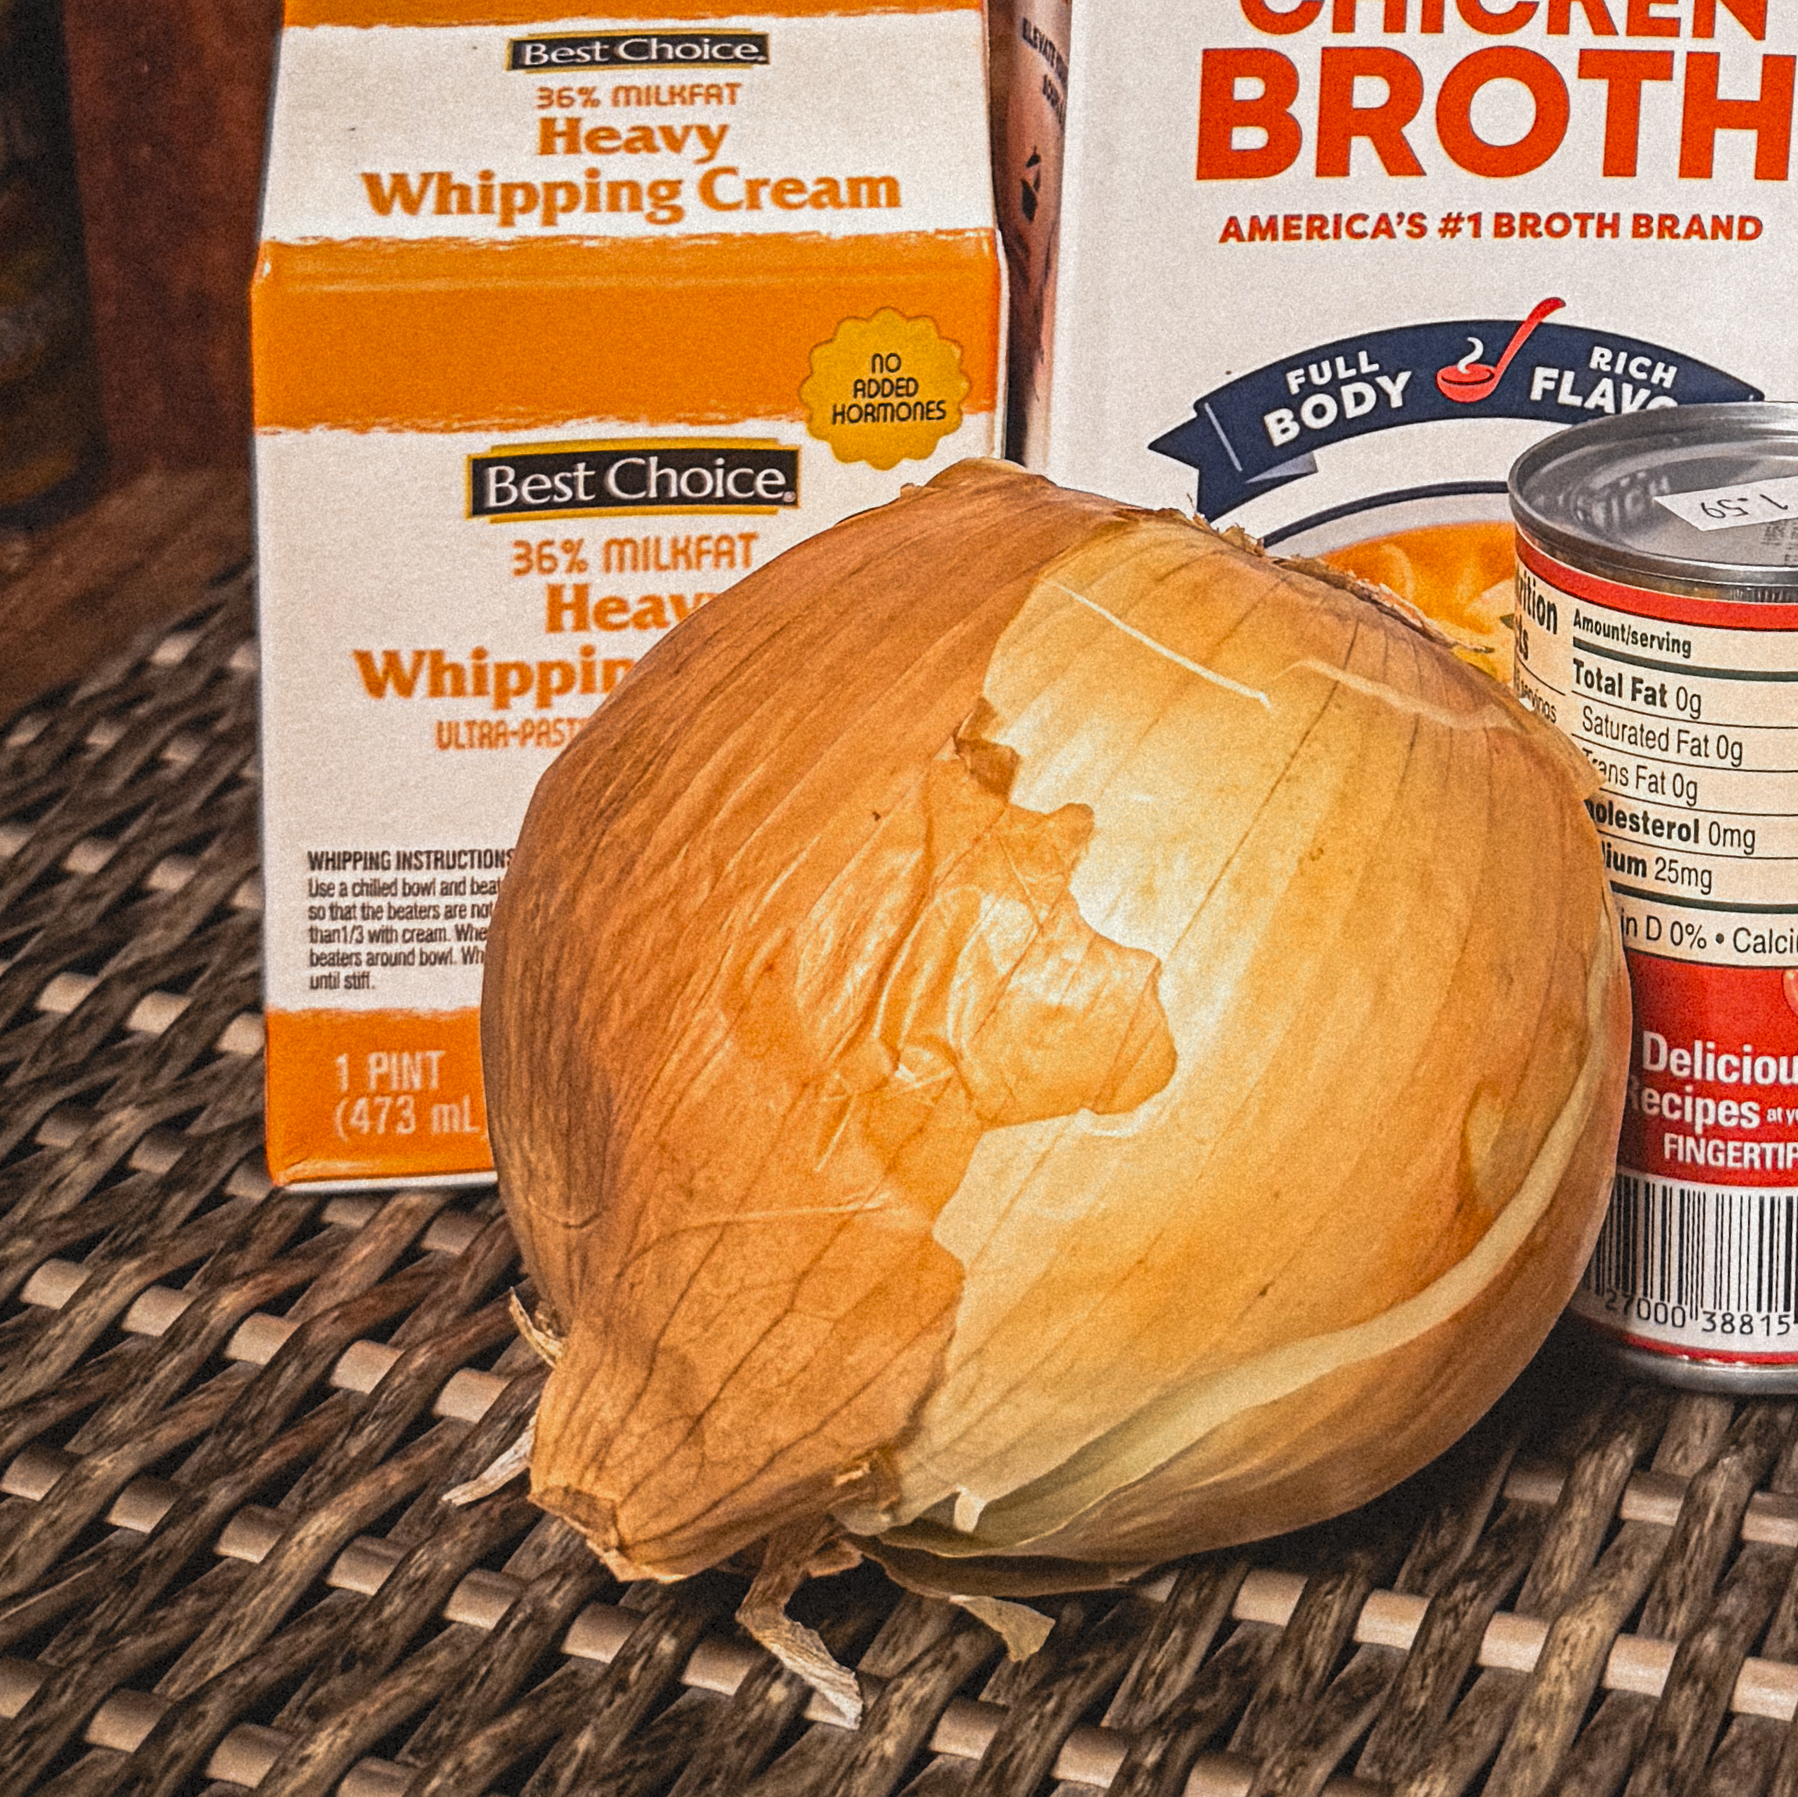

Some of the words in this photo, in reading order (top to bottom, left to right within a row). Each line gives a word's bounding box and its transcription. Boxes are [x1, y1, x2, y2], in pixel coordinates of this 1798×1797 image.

[523, 41, 608, 66] Best
[536, 85, 600, 109] 36%
[612, 83, 741, 108] MILKFAT
[1196, 46, 1797, 181] BROTH
[536, 118, 729, 163] Heavy
[361, 168, 683, 227] Whipping
[700, 168, 901, 210] Cream
[1219, 211, 1428, 243] AMERICA'S
[1438, 213, 1482, 238] #1
[1493, 211, 1619, 239] BROTH
[1631, 213, 1763, 241] BRAND
[872, 353, 901, 373] NO
[1286, 350, 1379, 394] FULL
[1589, 346, 1678, 388] RICH
[853, 378, 918, 398] ADDED
[832, 402, 946, 424] HORMONES
[1262, 370, 1412, 448] BODY
[486, 461, 596, 507] Best
[1700, 493, 1788, 520] 1.59
[512, 539, 588, 576] 36%
[604, 532, 758, 573] MILKFAT
[545, 582, 720, 633] Heav
[1573, 608, 1691, 658] Amount/serving
[1573, 658, 1623, 698] Total
[1631, 676, 1667, 708] Fat
[1676, 686, 1701, 719] 0g
[1581, 706, 1670, 752] Saturated
[1676, 728, 1711, 759] Fat
[1716, 734, 1743, 766] 0g
[1636, 765, 1666, 795] Fat
[1672, 772, 1697, 806] 0g
[1708, 821, 1755, 856] 0mg
[308, 850, 391, 871] WHIPPING
[1655, 857, 1712, 895] 25mg
[309, 878, 335, 898] Use
[340, 881, 348, 897] a
[352, 877, 398, 897] chilled
[402, 877, 436, 896] bowl
[440, 876, 466, 895] and
[309, 905, 326, 921] so
[330, 903, 357, 921] that
[361, 903, 384, 920] the
[388, 902, 440, 920] beaters
[444, 904, 467, 919] are
[368, 925, 398, 943] with
[402, 927, 451, 943] cream.
[1646, 915, 1662, 941] D
[1670, 921, 1707, 949] 0%
[310, 950, 362, 968] beaters
[366, 949, 415, 967] around
[419, 949, 457, 965] bowl.
[310, 972, 340, 990] until
[344, 972, 376, 990] stiff.
[336, 1053, 348, 1093] 1
[368, 1050, 446, 1091] PINT
[335, 1095, 416, 1142] (473
[1766, 1107, 1782, 1123] at
[1702, 1310, 1790, 1336] 38815
